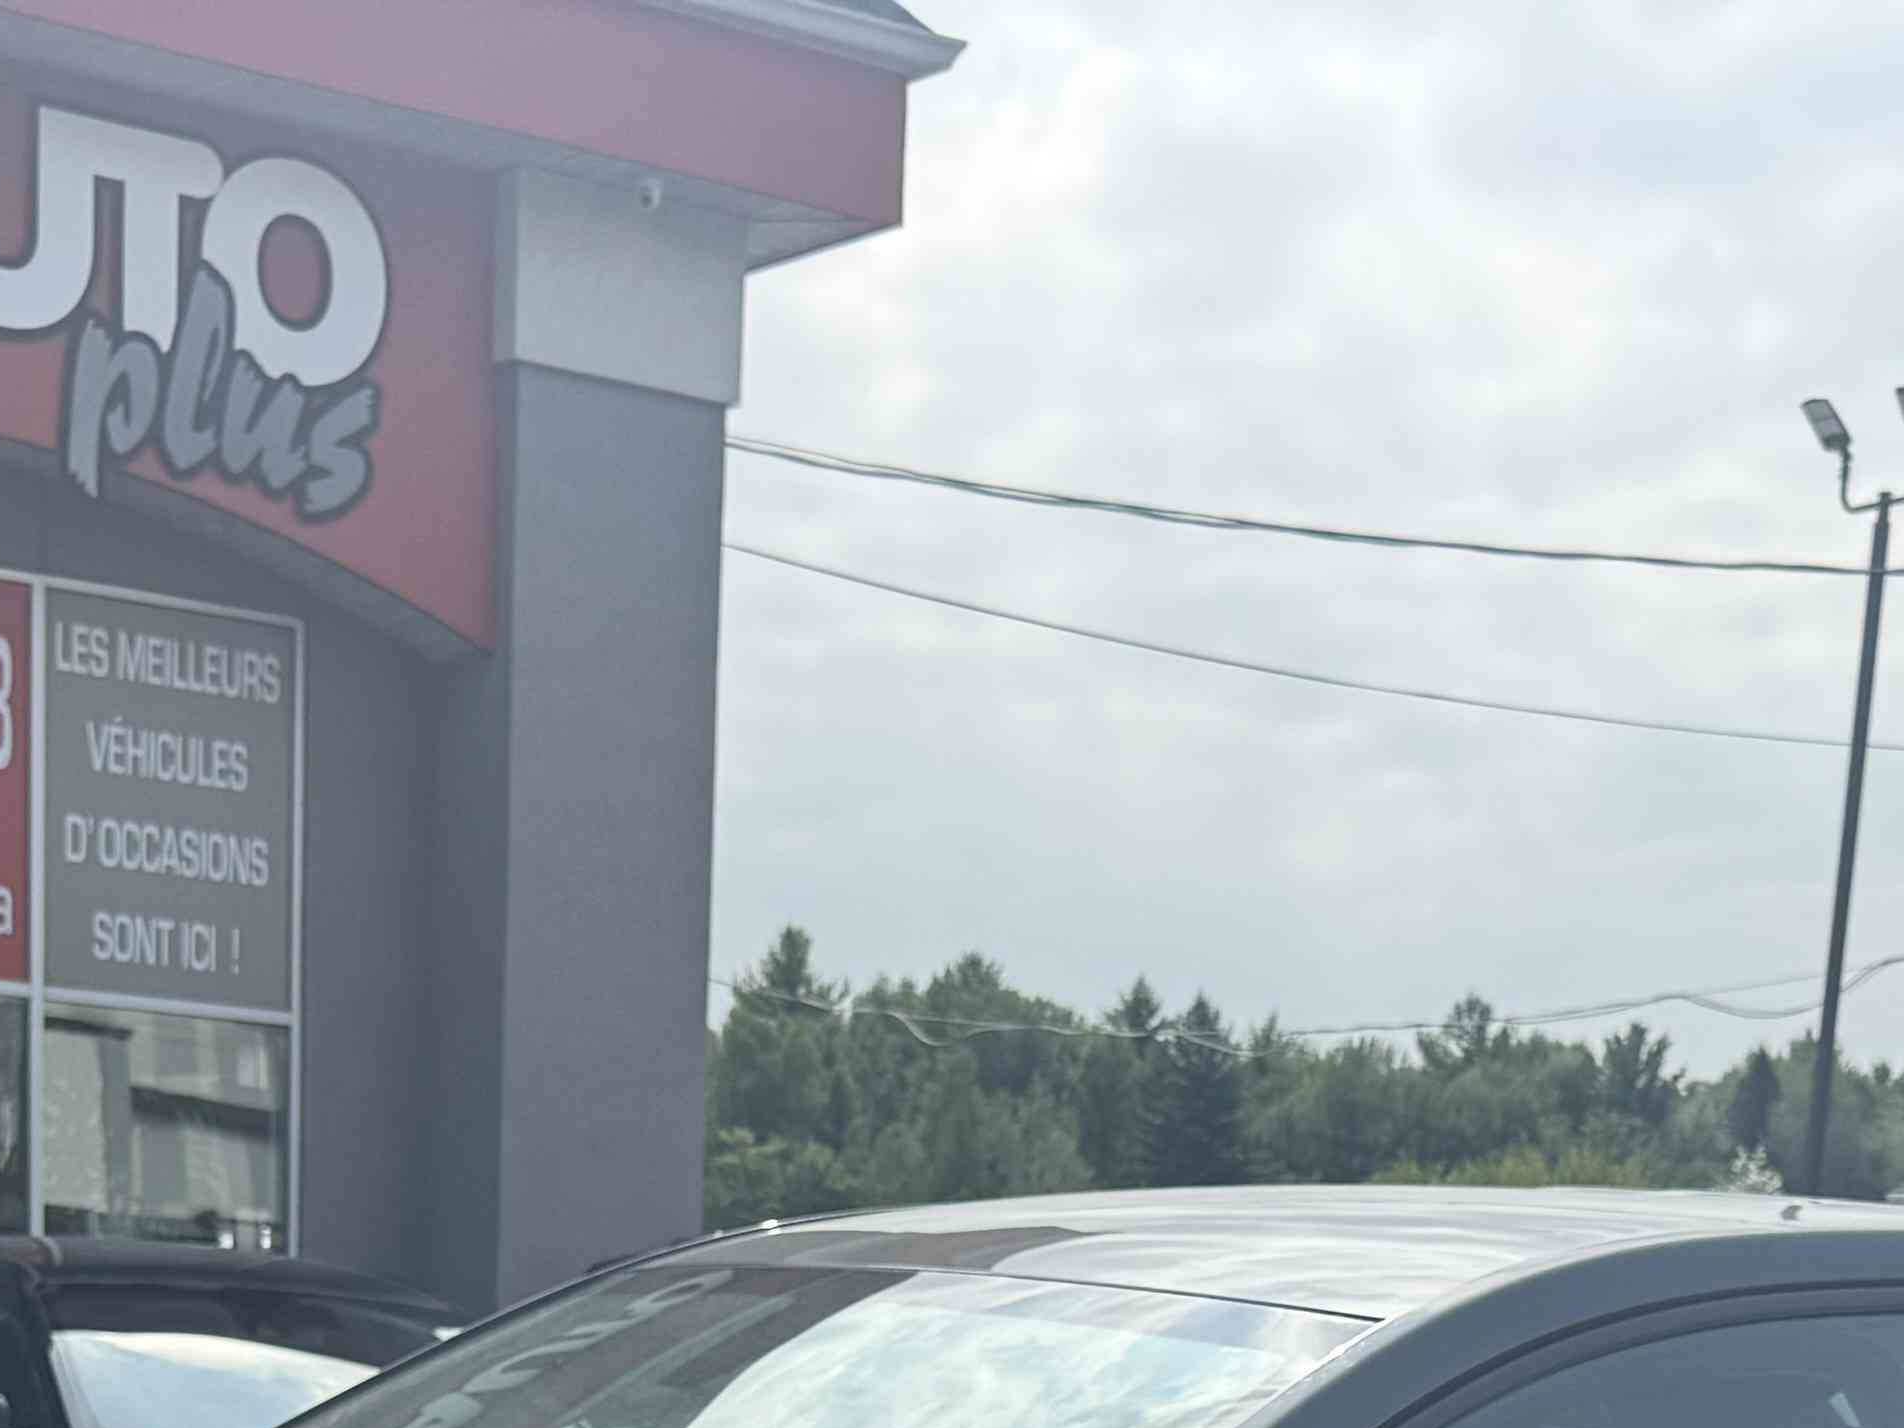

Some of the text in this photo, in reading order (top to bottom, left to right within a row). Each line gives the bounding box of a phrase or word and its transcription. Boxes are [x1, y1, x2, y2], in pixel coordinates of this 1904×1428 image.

[64, 258, 376, 516] plus
[53, 621, 281, 704] LES MEILLEURS
[85, 716, 248, 792] VÉHICULES
[63, 813, 270, 886] D'OCCASIONS
[91, 912, 176, 968] SONT
